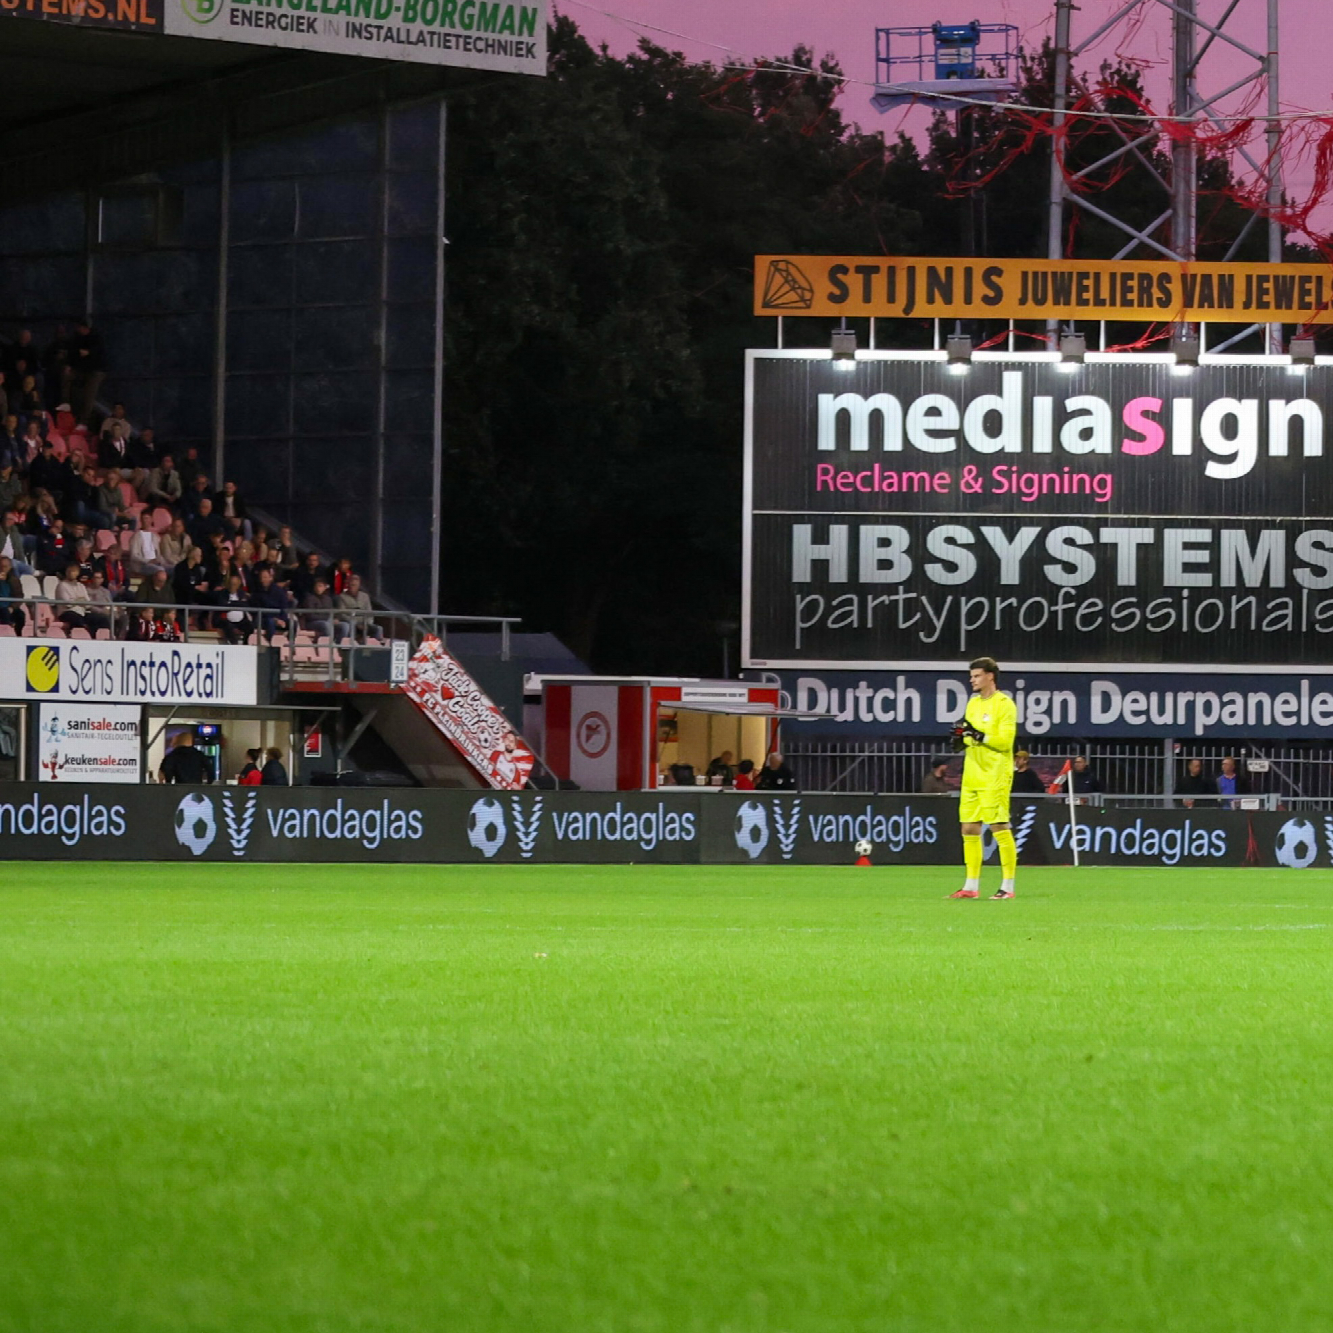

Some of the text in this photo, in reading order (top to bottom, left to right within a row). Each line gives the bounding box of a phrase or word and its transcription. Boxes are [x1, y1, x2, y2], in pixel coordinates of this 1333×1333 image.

[229, 8, 536, 60] ENERGIEK IN INSTALLATIETECHNIEK
[827, 264, 1004, 315] STIJNIS
[1018, 268, 1172, 309] JUWELIERS
[1180, 271, 1235, 310] VAN
[817, 371, 1323, 479] mediasign
[817, 464, 1113, 503] Reclame & Signing
[69, 645, 225, 698] Sens InstoRetail
[441, 662, 471, 697] Jack
[67, 717, 138, 731] sanisale.com
[448, 697, 482, 734] Goals
[796, 677, 920, 724] Dutch
[936, 677, 1077, 735] Dign
[64, 753, 138, 766] keukensale.com
[266, 798, 424, 849] vandaglas
[552, 801, 696, 851] vandaglas
[808, 804, 937, 852] vandaglas
[1049, 818, 1227, 865] vandaglas
